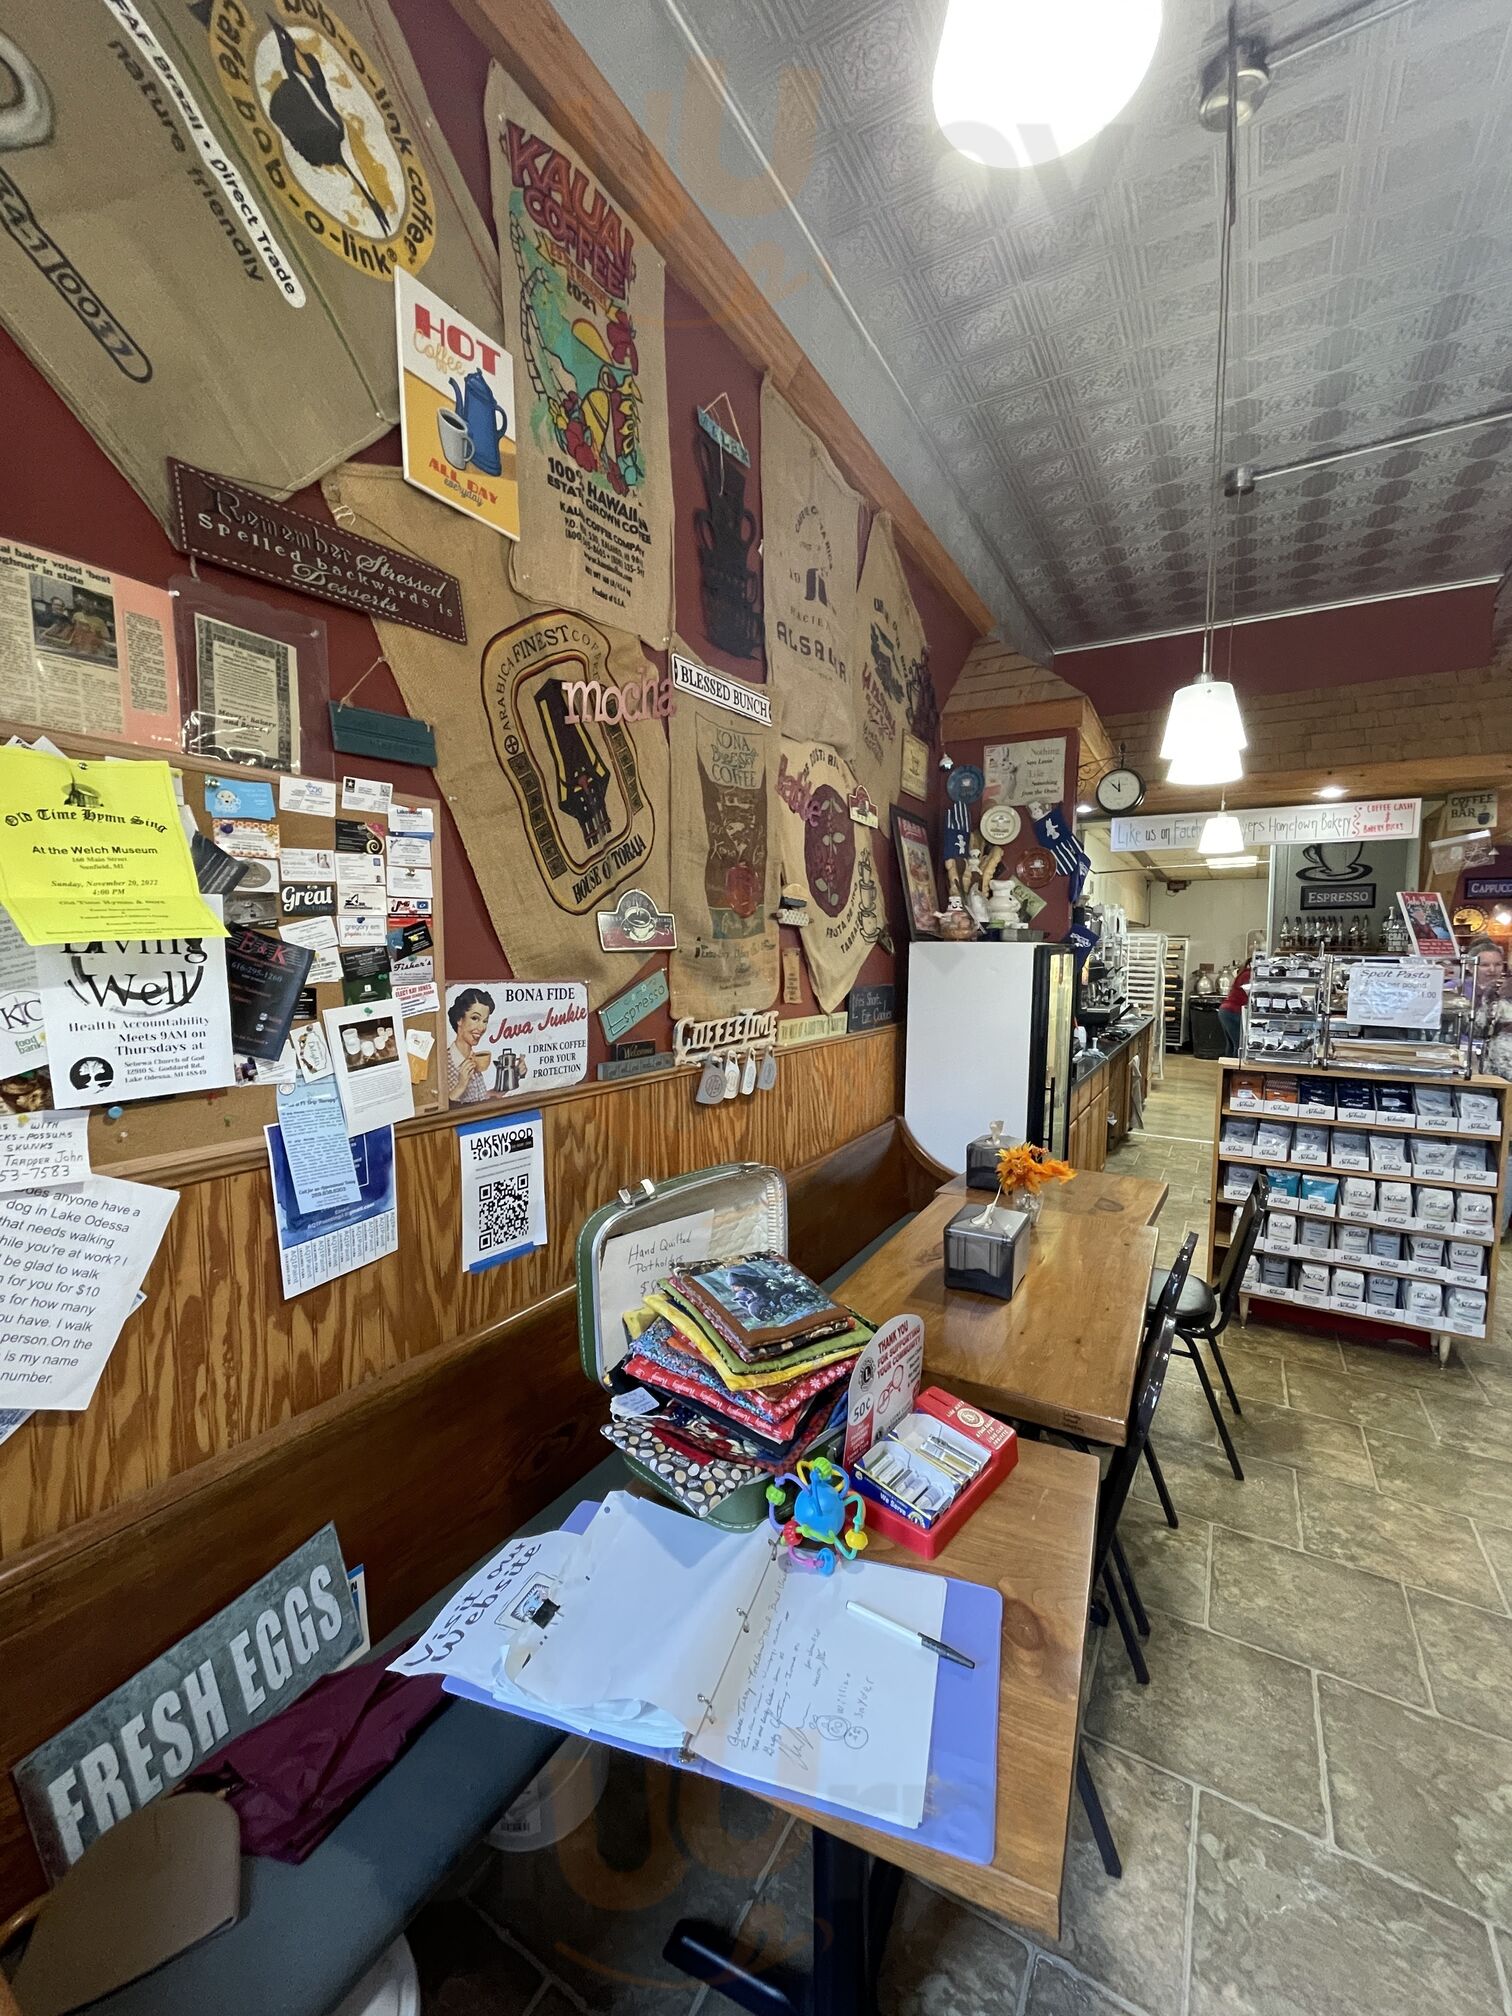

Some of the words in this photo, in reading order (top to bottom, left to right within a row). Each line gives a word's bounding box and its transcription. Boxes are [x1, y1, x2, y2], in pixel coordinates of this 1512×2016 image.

[107, 40, 186, 152] nature
[187, 166, 266, 283] friendly
[208, 158, 260, 227] Direct
[256, 230, 297, 298] Trade
[415, 303, 501, 377] HOT
[428, 457, 461, 483] ALL
[466, 477, 498, 505] DAY
[197, 512, 302, 562] Spelled
[316, 557, 430, 609] backwards
[291, 562, 400, 613] Desserts
[355, 553, 447, 600] Stressed
[512, 624, 569, 664] FINEST
[561, 666, 677, 726] mocha
[680, 665, 730, 701] BLESSED
[733, 688, 768, 718] BUNCH
[5, 811, 33, 828] Old
[37, 808, 77, 822] Time
[83, 808, 126, 823] Hymn
[130, 815, 168, 834] Sing
[1451, 808, 1477, 819] BAR
[1117, 825, 1142, 846] Like
[1145, 823, 1157, 842] us
[1268, 815, 1319, 842] Hometown
[32, 845, 46, 855] At
[48, 846, 68, 855] the
[70, 846, 109, 855] Welch
[112, 846, 158, 855] Museum
[51, 880, 84, 889] Sunday,
[1308, 891, 1369, 904] ESPRESSO
[282, 885, 333, 912] Great
[393, 959, 432, 973] Fisher's
[1359, 969, 1393, 979] Spelt
[1396, 969, 1432, 979] Pasta
[85, 971, 192, 1008] Well
[505, 987, 543, 1002] BONA
[547, 987, 576, 1001] FIDE
[489, 1018, 534, 1044] Java
[538, 1002, 588, 1031] Junkie
[604, 983, 666, 1038] Espresso
[69, 1021, 116, 1032] Health
[120, 1017, 209, 1030] Accountability
[119, 1032, 157, 1043] Meets
[160, 1030, 188, 1041] 9AM
[192, 1030, 207, 1038] on
[15, 1036, 38, 1048] food
[115, 1042, 187, 1057] Thursdays
[191, 1042, 204, 1051] at
[533, 1042, 558, 1053] DRINK
[559, 1039, 587, 1050] COFFEE
[533, 1063, 582, 1079] PROTECTION
[539, 1055, 555, 1065] FOR
[556, 1052, 576, 1063] YOUR
[31, 1122, 60, 1130] WITH
[470, 1127, 534, 1151] LAKEWOOD
[7, 1143, 53, 1152] SKUNKS
[55, 1150, 83, 1164] John
[473, 1140, 512, 1161] BOND
[6, 1200, 33, 1216] dog
[35, 1203, 47, 1216] in
[51, 1207, 81, 1223] Lake
[84, 1214, 130, 1233] Odessa
[53, 1191, 99, 1209] anyone
[101, 1200, 130, 1216] have
[132, 1209, 141, 1217] a
[0, 1215, 24, 1229] that
[26, 1223, 67, 1239] needs
[69, 1231, 115, 1249] walking
[26, 1242, 66, 1257] you're
[68, 1247, 82, 1259] at
[84, 1252, 121, 1267] work?
[627, 1243, 655, 1265] Hand
[659, 1231, 693, 1251] Quilted
[4, 1254, 21, 1267] be
[23, 1258, 55, 1272] glad
[56, 1263, 68, 1276] to
[71, 1268, 100, 1280] walk
[7, 1274, 27, 1287] for
[28, 1279, 53, 1293] you
[55, 1281, 74, 1294] for
[76, 1284, 101, 1298] $10
[9, 1293, 28, 1307] for
[30, 1296, 59, 1311] how
[60, 1301, 97, 1317] many
[16, 1312, 51, 1329] have.
[64, 1320, 94, 1332] walk
[73, 1338, 93, 1351] the
[877, 1354, 888, 1369] FOR
[889, 1327, 921, 1360] SUPPORTING
[878, 1331, 897, 1355] THANK
[898, 1319, 909, 1335] YOU
[4, 1350, 16, 1363] is
[19, 1354, 41, 1367] my
[43, 1355, 79, 1368] name
[877, 1361, 893, 1379] YOUR
[852, 1397, 871, 1423] 50¢
[430, 1543, 542, 1663] Website
[403, 1588, 483, 1667] Visit
[47, 1658, 229, 1866] FRESH
[229, 1563, 344, 1717] EGGS
